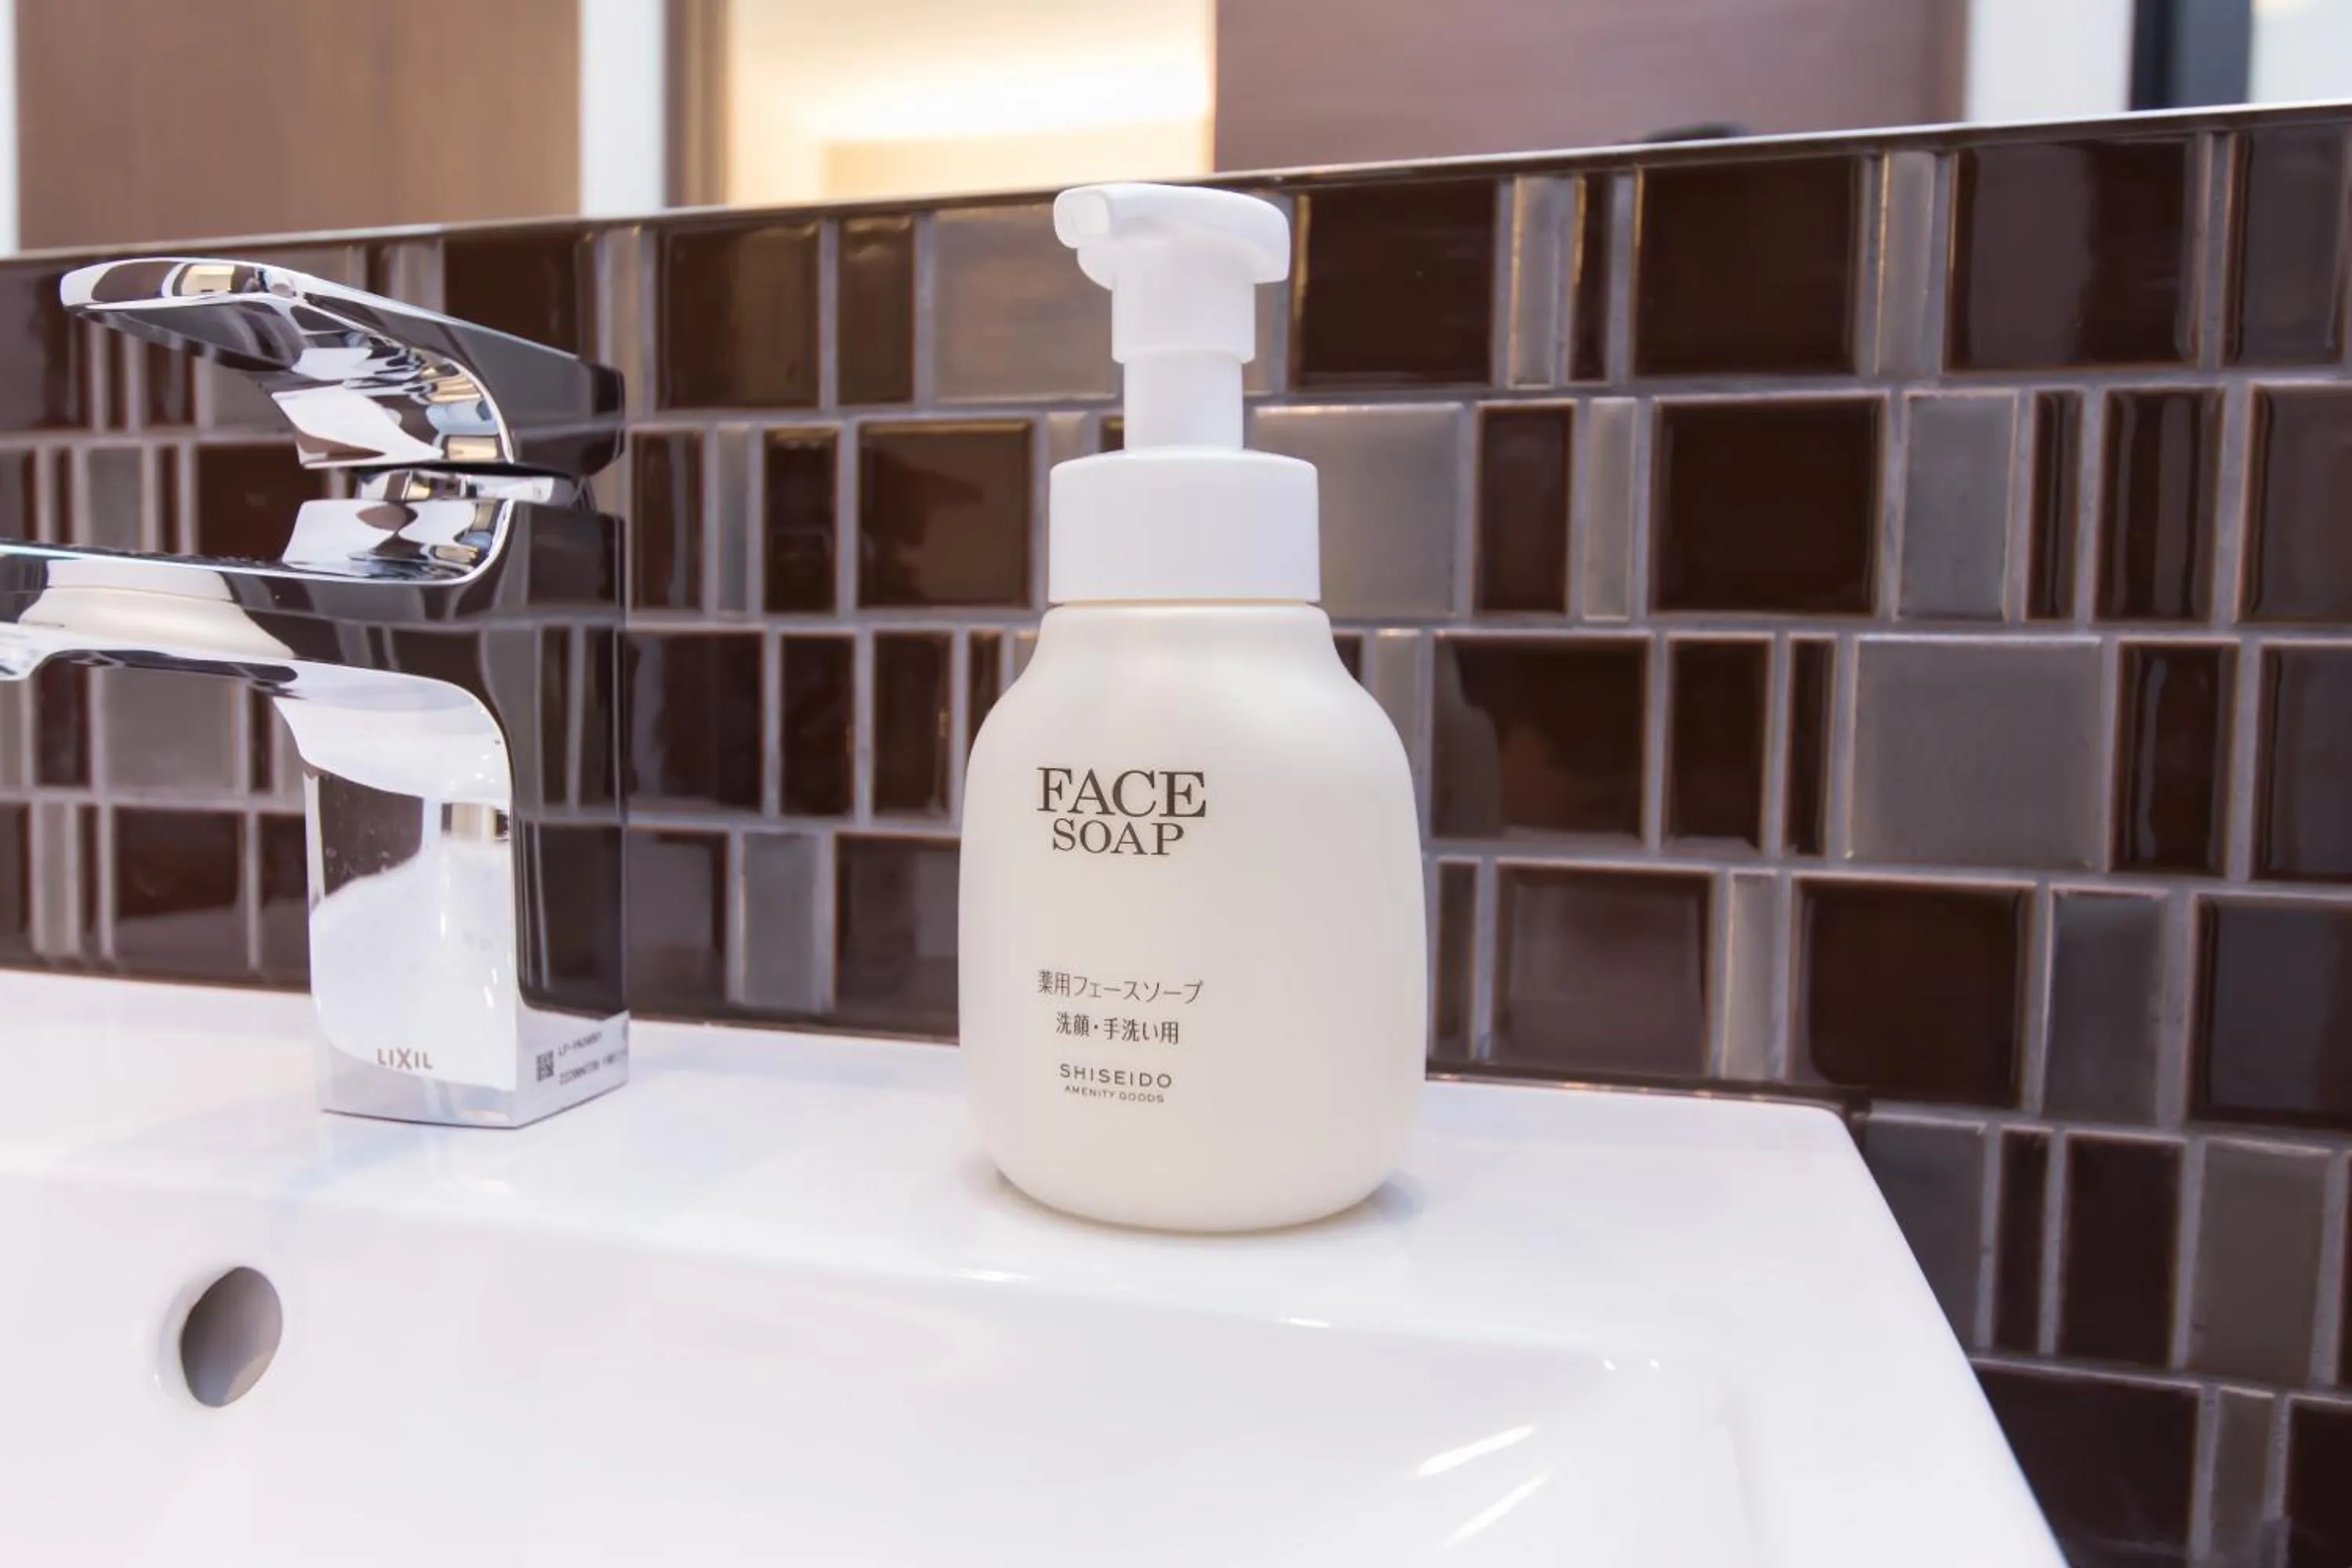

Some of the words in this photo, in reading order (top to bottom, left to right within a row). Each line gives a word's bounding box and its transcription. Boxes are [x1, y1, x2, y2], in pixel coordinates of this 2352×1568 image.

[1036, 767, 1206, 817] FACE
[1051, 818, 1185, 855] SOAP
[1037, 969, 1203, 1004] 薬用フェースソープ
[1056, 1011, 1179, 1045] 洗顔・手洗い用
[377, 1046, 433, 1071] LIXIL
[1060, 1063, 1172, 1088] SHISEIDO
[1064, 1084, 1115, 1098] AMENITY
[1119, 1091, 1164, 1103] GOODS
